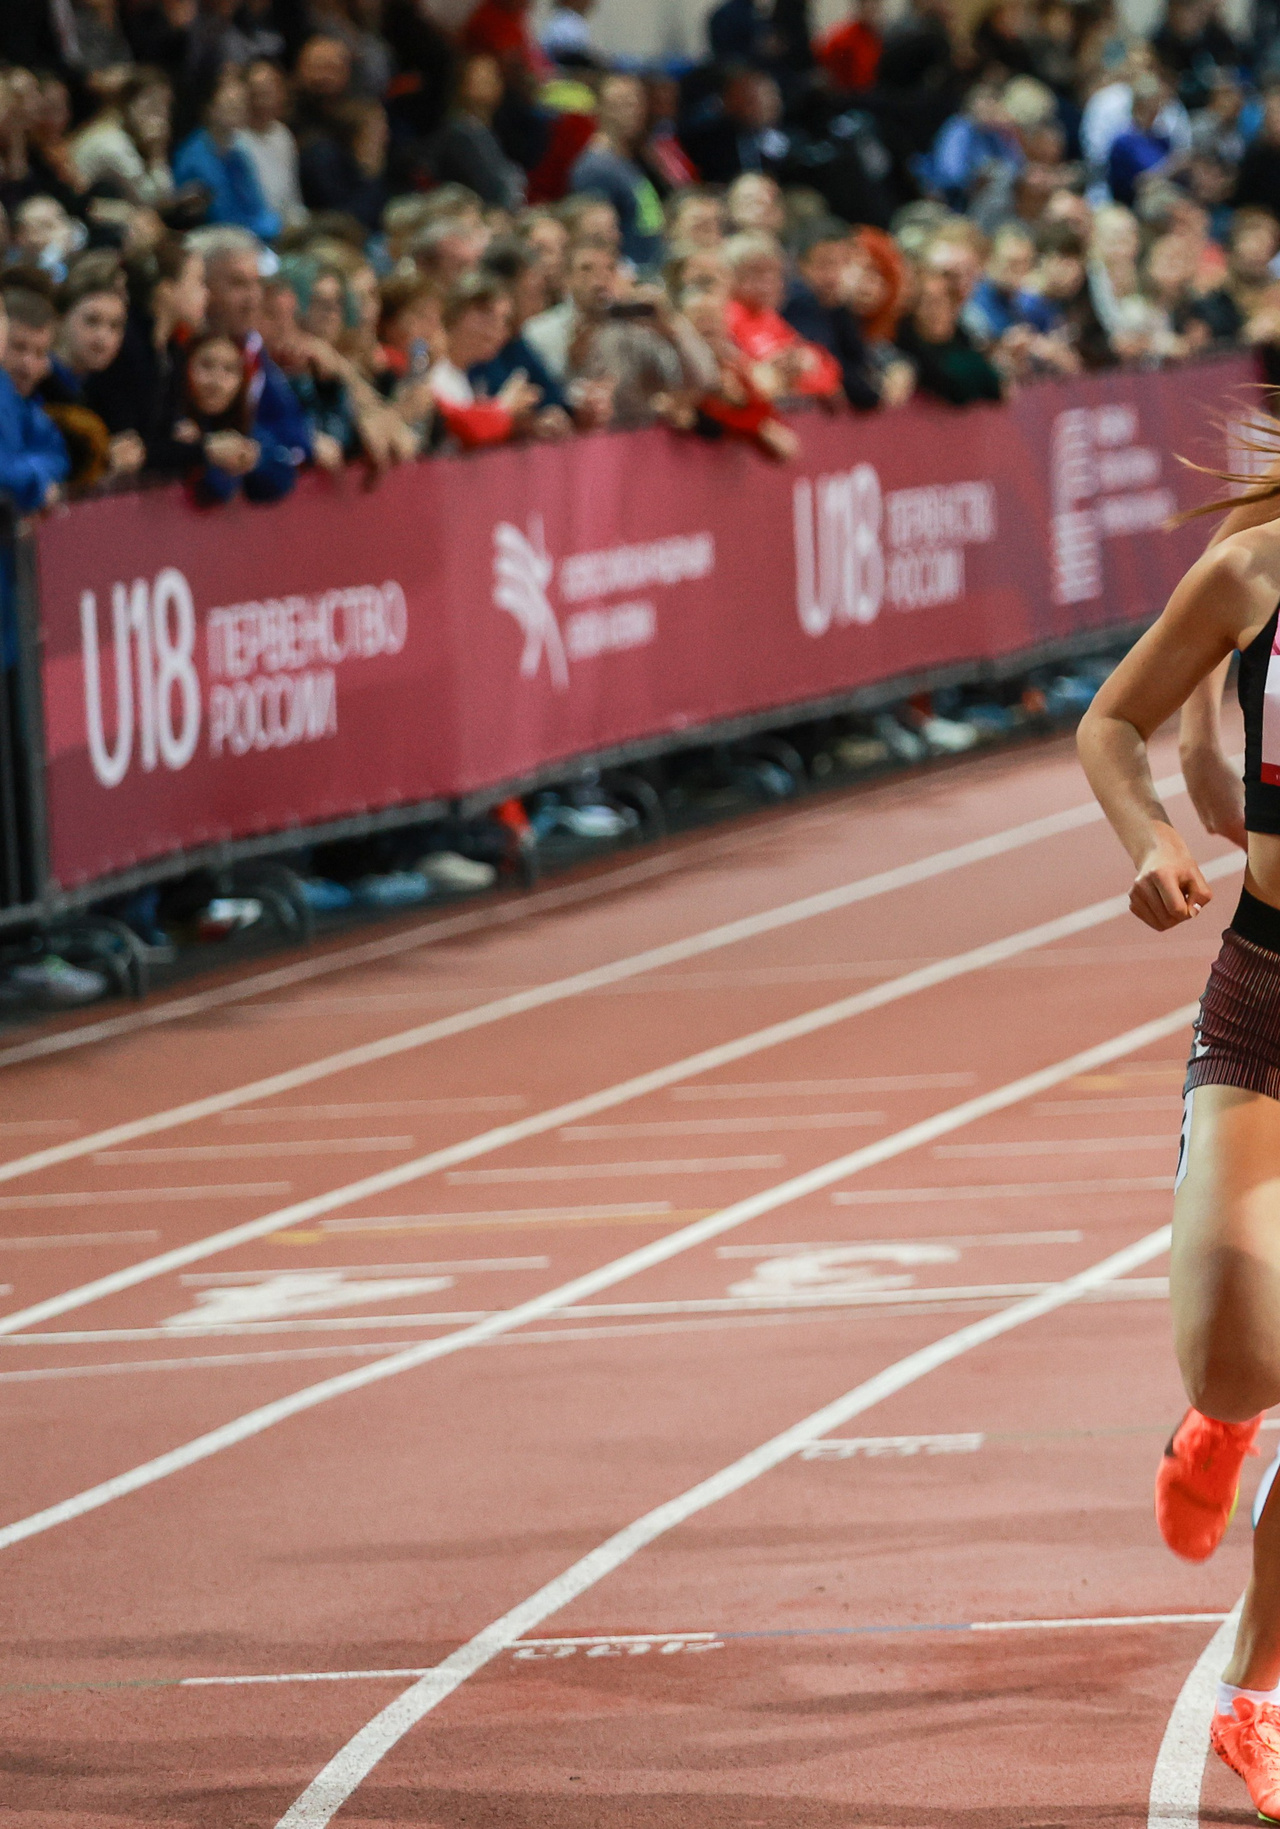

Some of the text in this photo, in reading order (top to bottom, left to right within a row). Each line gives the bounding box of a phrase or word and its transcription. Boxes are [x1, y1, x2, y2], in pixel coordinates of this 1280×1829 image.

[80, 566, 201, 789] U18
[207, 580, 407, 678] ПЕРВЕНСТВО
[209, 670, 338, 758] РОССИИ
